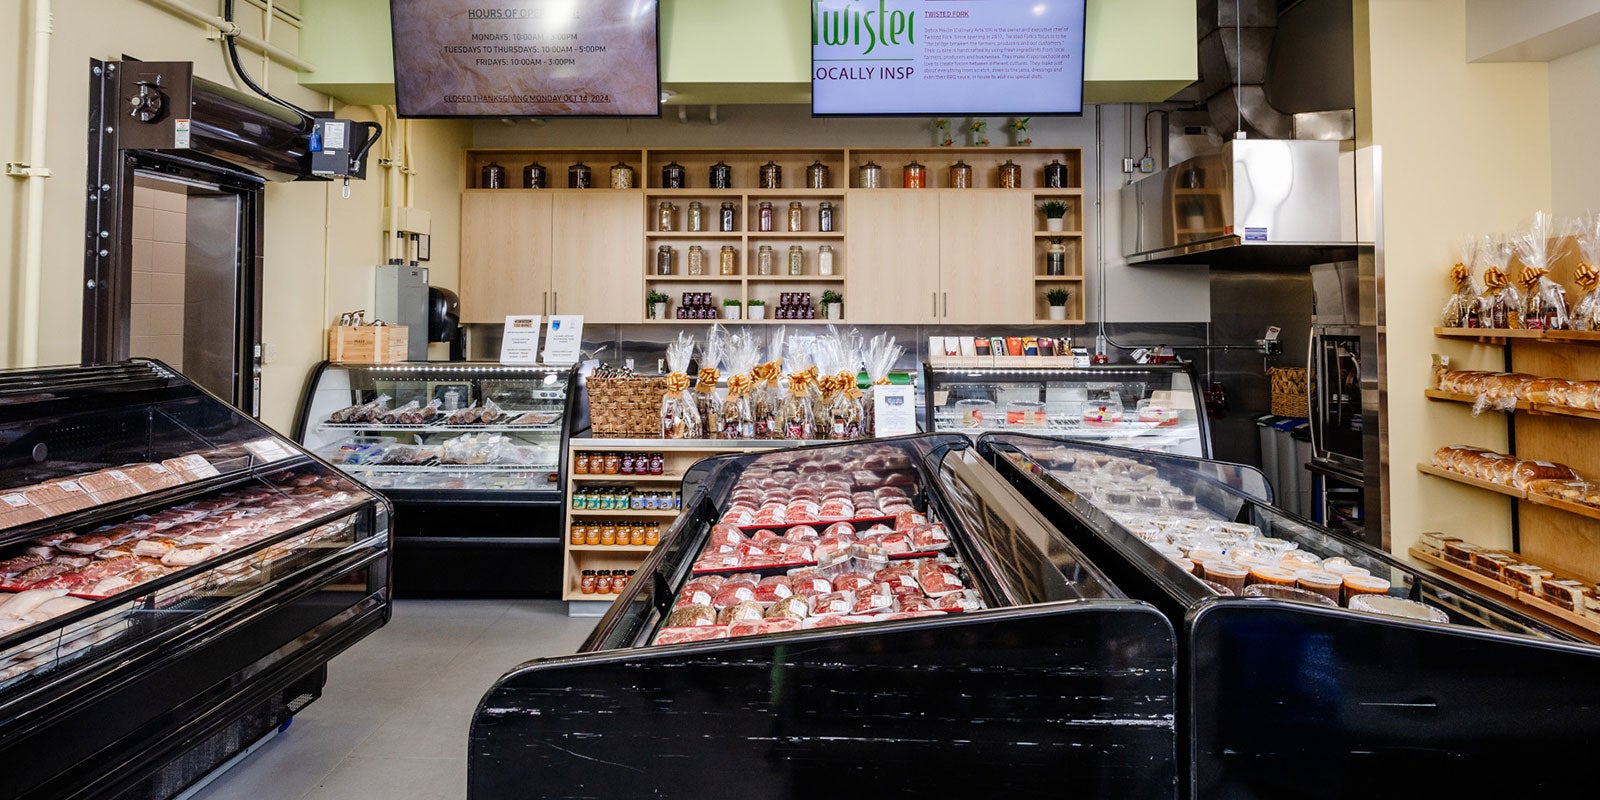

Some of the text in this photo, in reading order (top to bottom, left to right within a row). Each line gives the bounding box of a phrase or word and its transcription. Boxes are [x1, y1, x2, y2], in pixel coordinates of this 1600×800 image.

[468, 8, 503, 19] HOURS
[505, 8, 517, 19] OF
[471, 33, 511, 41] MONDAYS:
[813, 67, 875, 80] OCALLY
